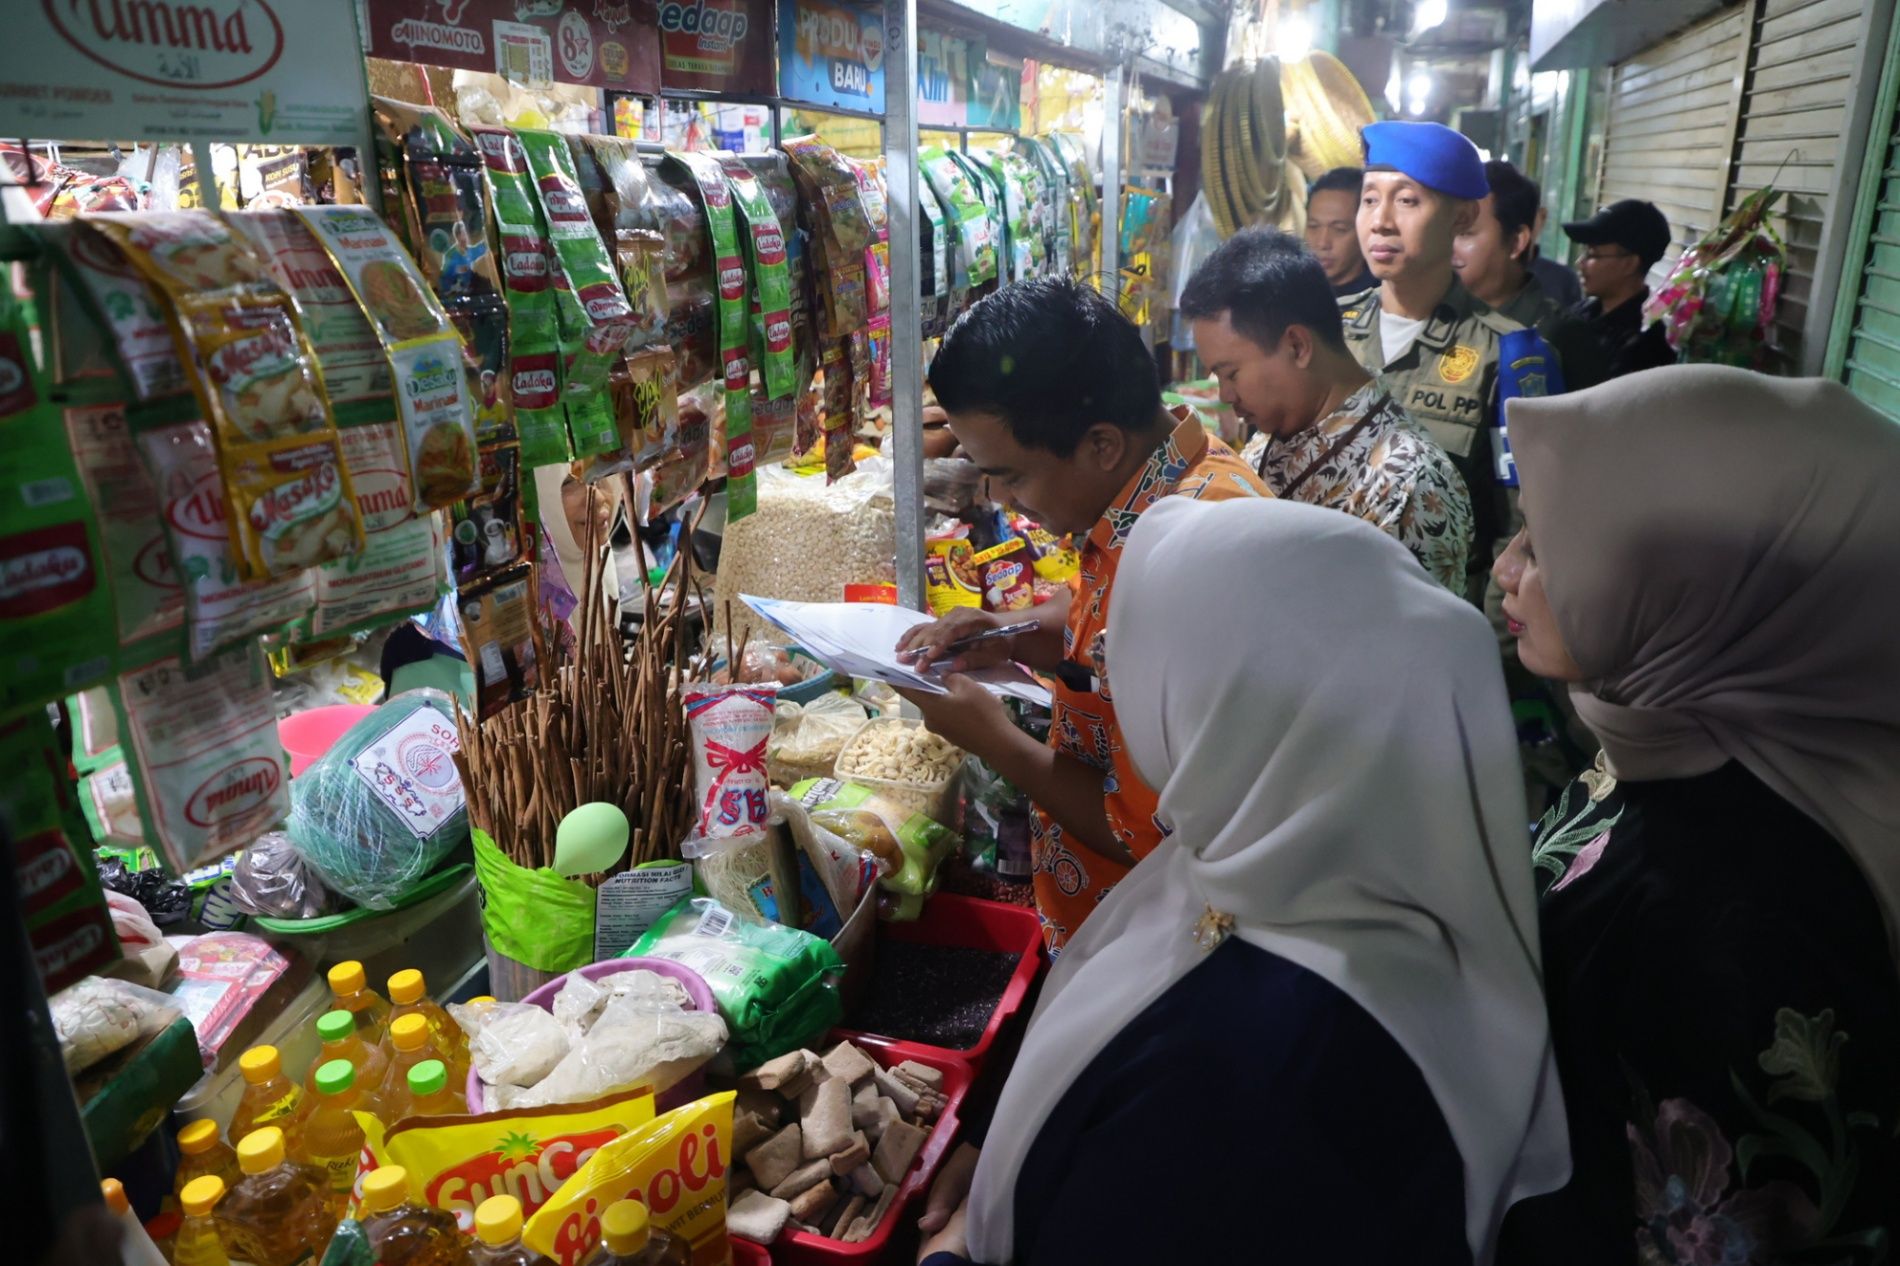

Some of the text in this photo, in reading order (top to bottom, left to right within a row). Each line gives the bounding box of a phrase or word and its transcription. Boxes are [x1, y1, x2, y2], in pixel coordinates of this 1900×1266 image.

[659, 0, 746, 43] edaap
[799, 9, 862, 52] PRODU
[391, 24, 482, 51] AJINOMOTO
[834, 62, 866, 93] BARU
[515, 372, 552, 391] Ladaku
[1411, 389, 1479, 414] POL PP
[553, 1123, 724, 1266] Bioli
